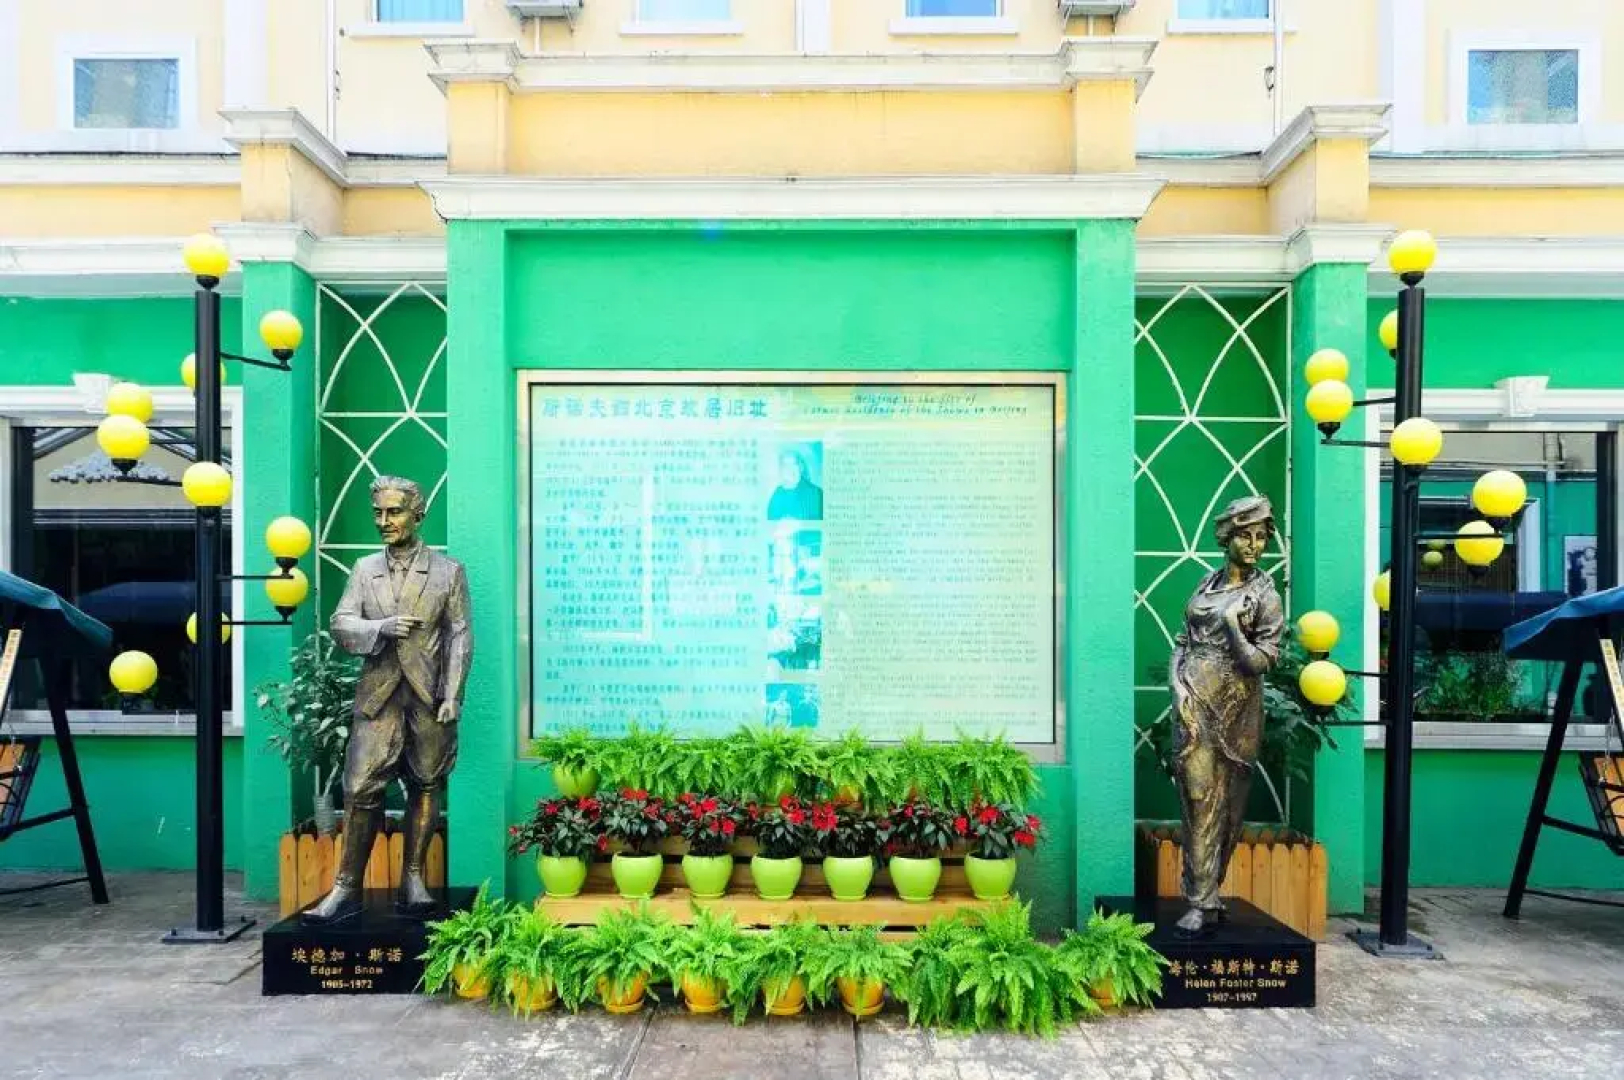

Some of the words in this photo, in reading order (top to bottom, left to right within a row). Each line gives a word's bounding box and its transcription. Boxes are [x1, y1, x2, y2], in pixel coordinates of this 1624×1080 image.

[310, 965, 343, 976] Edgar
[354, 965, 384, 975] Snow
[321, 980, 373, 989] 1905-1972
[1185, 978, 1216, 988] Helen
[1220, 978, 1254, 987] Foster
[1257, 978, 1287, 987] Snow
